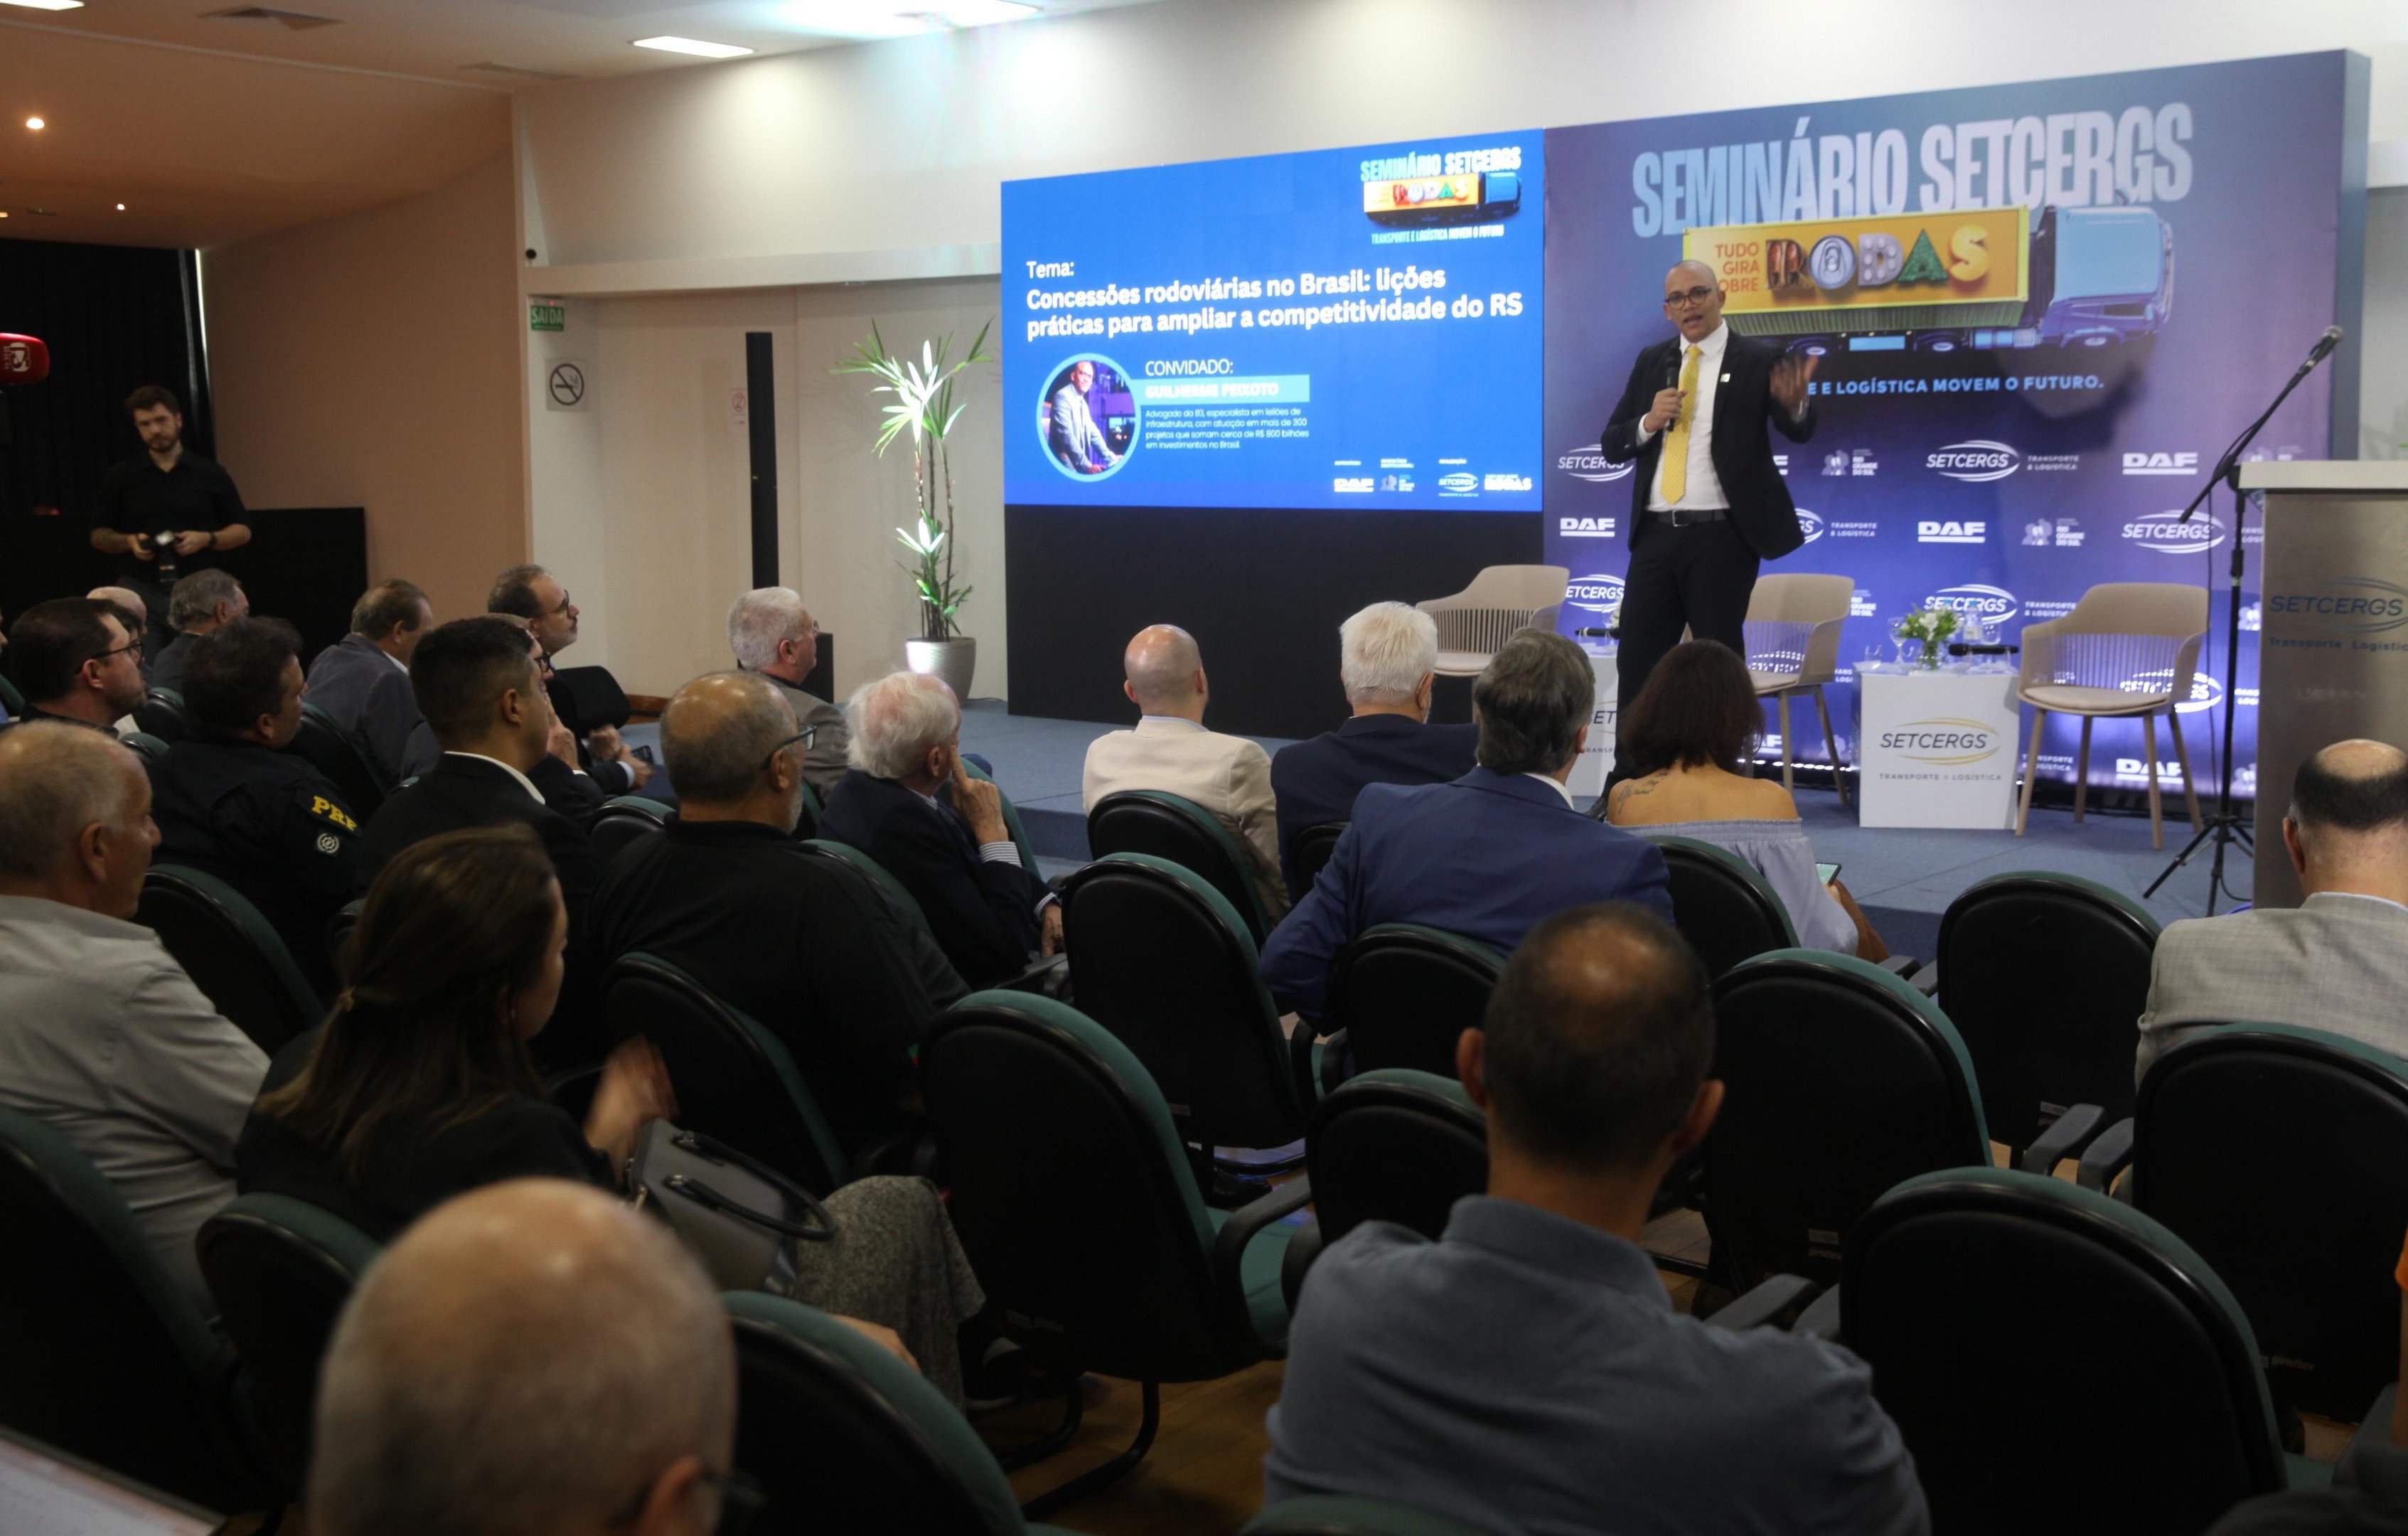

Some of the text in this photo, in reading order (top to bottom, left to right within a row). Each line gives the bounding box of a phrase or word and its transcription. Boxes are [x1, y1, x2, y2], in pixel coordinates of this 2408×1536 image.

[1361, 146, 1521, 181] SEMINÁRIO SETCERGS
[1632, 102, 2193, 238] SEMINÁRIO SETCERGS
[1715, 242, 1760, 258] TUDO
[1765, 225, 1989, 290] RODAS
[1026, 261, 1074, 279] Tema:
[1723, 260, 1760, 275] GIRA
[1027, 266, 1446, 309] Concessões rodoviárias no Brasil: lições
[1718, 277, 1760, 293] OBRE
[1027, 292, 1523, 342] práticas para ampliar a competitividade do RS
[1145, 358, 1234, 376] CONVIDADO:
[1145, 383, 1279, 398] GUILHERME PEIXOTO
[1821, 382, 1831, 395] E
[1836, 377, 1926, 395] LOGÍSTICA
[1932, 378, 1999, 393] MOVEM
[2005, 377, 2018, 391] O
[2023, 375, 2104, 390] FUTURO.
[1145, 410, 1182, 419] Advogado
[1206, 408, 1250, 419] especialista
[1265, 407, 1288, 416] leilões
[1145, 420, 1194, 428] infraestrutura,
[1213, 419, 1245, 429] atuação
[1261, 418, 1279, 427] mais
[1145, 431, 1174, 440] projetos
[1175, 431, 1189, 439] que
[1282, 429, 1309, 437] bilhões
[1160, 440, 1207, 449] investimentos
[1557, 457, 1625, 469] SETCER
[1926, 453, 2009, 469] SETCERGS
[2122, 452, 2198, 466] DAF
[1561, 518, 1615, 531] DAF
[1917, 521, 1986, 535] DAF
[2121, 523, 2214, 539] SETCERGS
[1566, 585, 1625, 599] ETCERGS
[2269, 596, 2403, 616] SETCERGS
[2269, 636, 2343, 649] Transporte
[1880, 733, 1987, 748] SETCERGS
[2116, 758, 2182, 777] DAF
